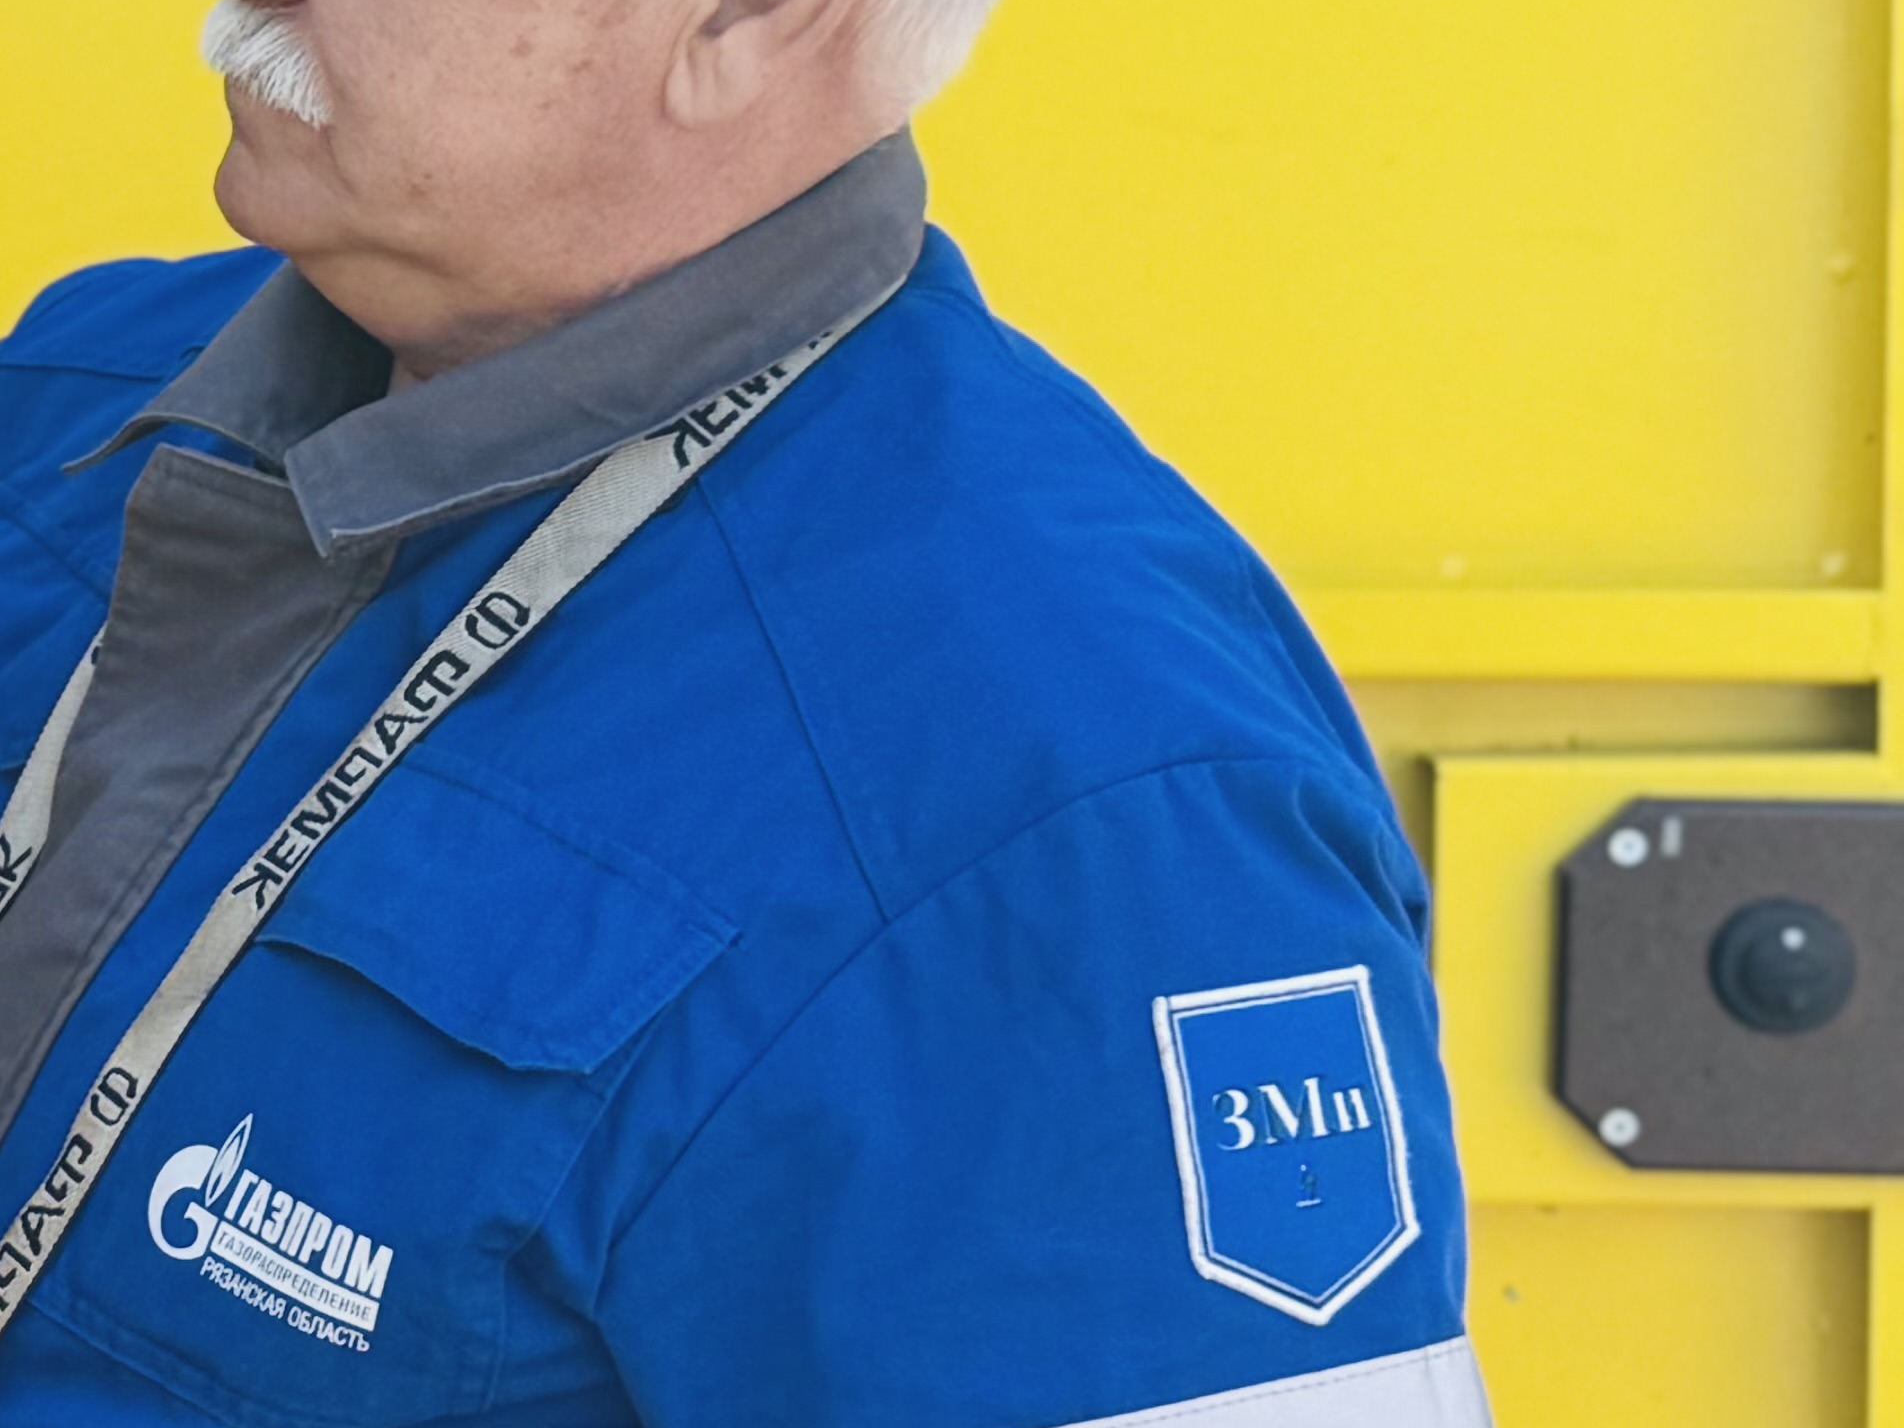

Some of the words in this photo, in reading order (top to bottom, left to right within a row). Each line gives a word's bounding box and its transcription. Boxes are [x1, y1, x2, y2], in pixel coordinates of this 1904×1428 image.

[217, 1230, 372, 1323] ГАЗОРАСПРЕДЕЛЕНИЕ
[225, 1167, 394, 1299] ГАЗПРОМ
[200, 1256, 287, 1321] РЯЗАНСКАЯ
[287, 1305, 371, 1353] ОБЛАСТЬ
